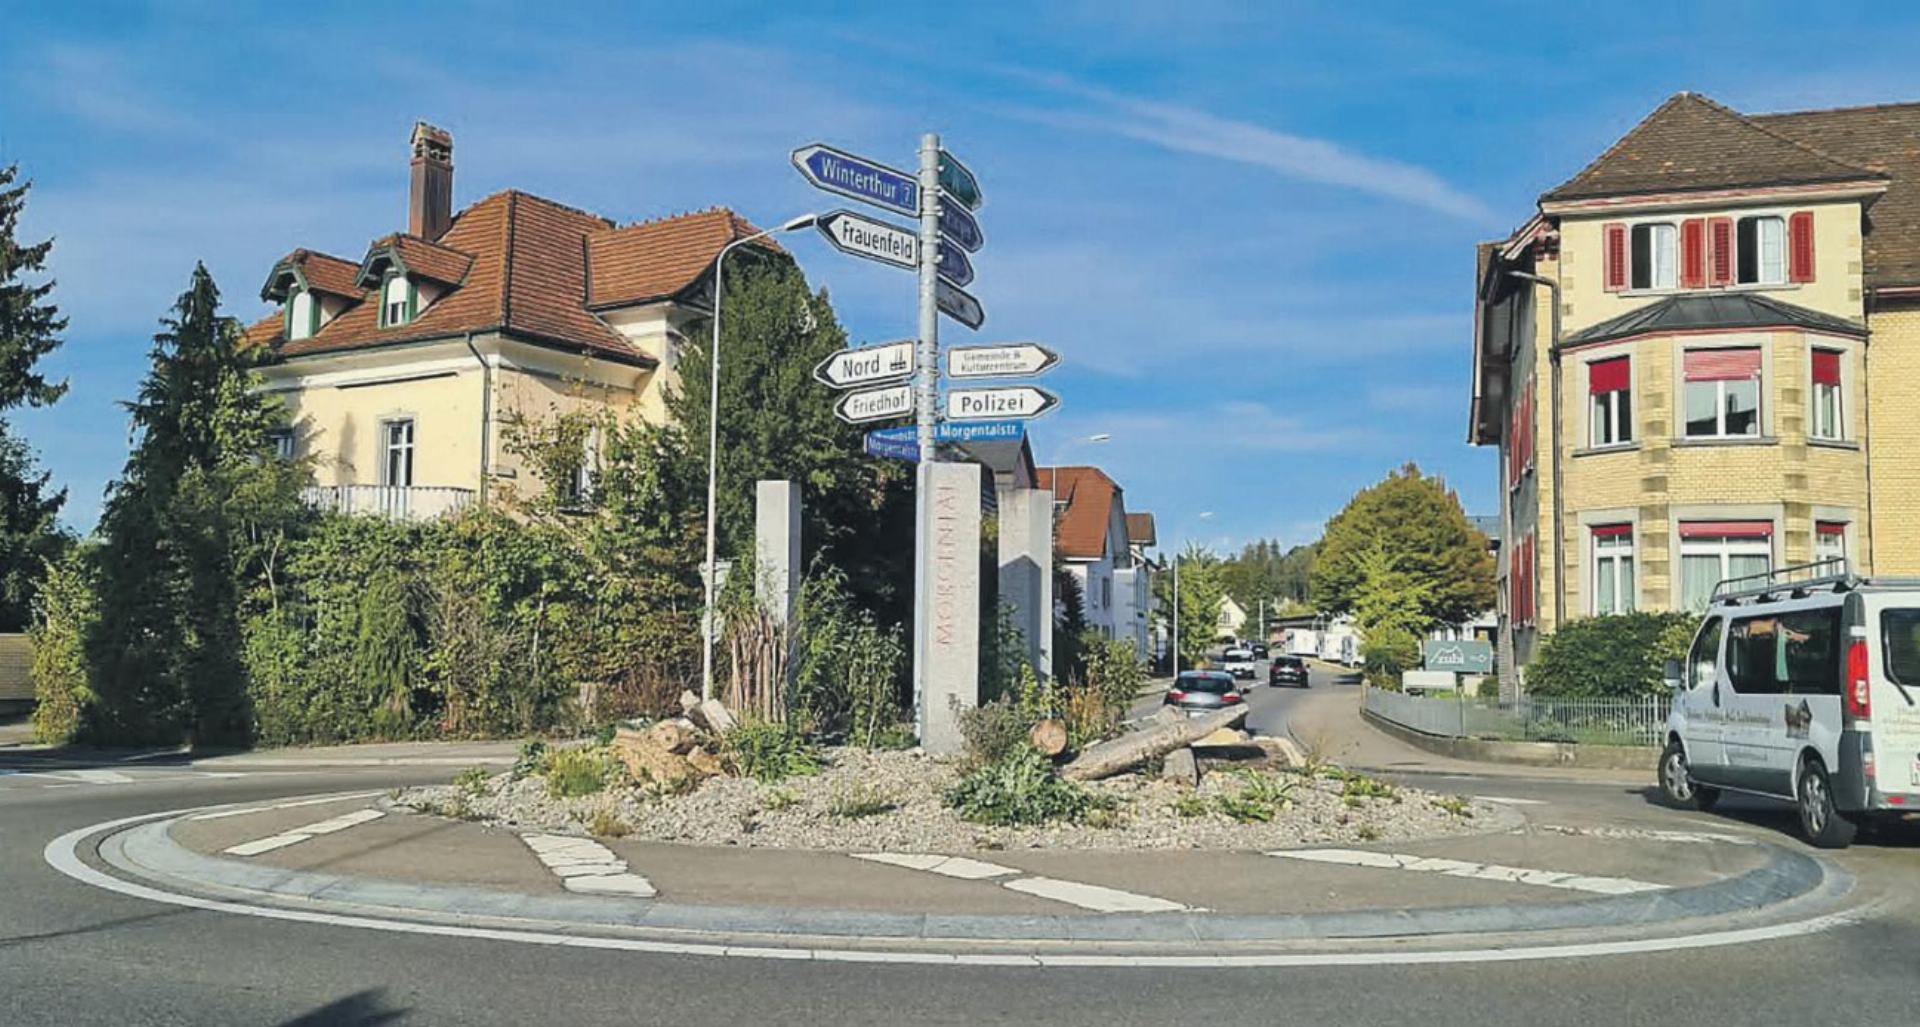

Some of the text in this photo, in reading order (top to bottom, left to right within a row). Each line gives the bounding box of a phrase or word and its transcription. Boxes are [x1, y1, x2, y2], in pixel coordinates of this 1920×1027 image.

[821, 156, 911, 202] Winterthur 7
[842, 219, 914, 260] Frauenfeld
[842, 353, 880, 379] Nord
[963, 350, 1011, 361] Gemeinde
[961, 361, 1028, 373] Kulturzentrum
[853, 393, 906, 414] Friedhof
[961, 393, 1024, 413] Polizei
